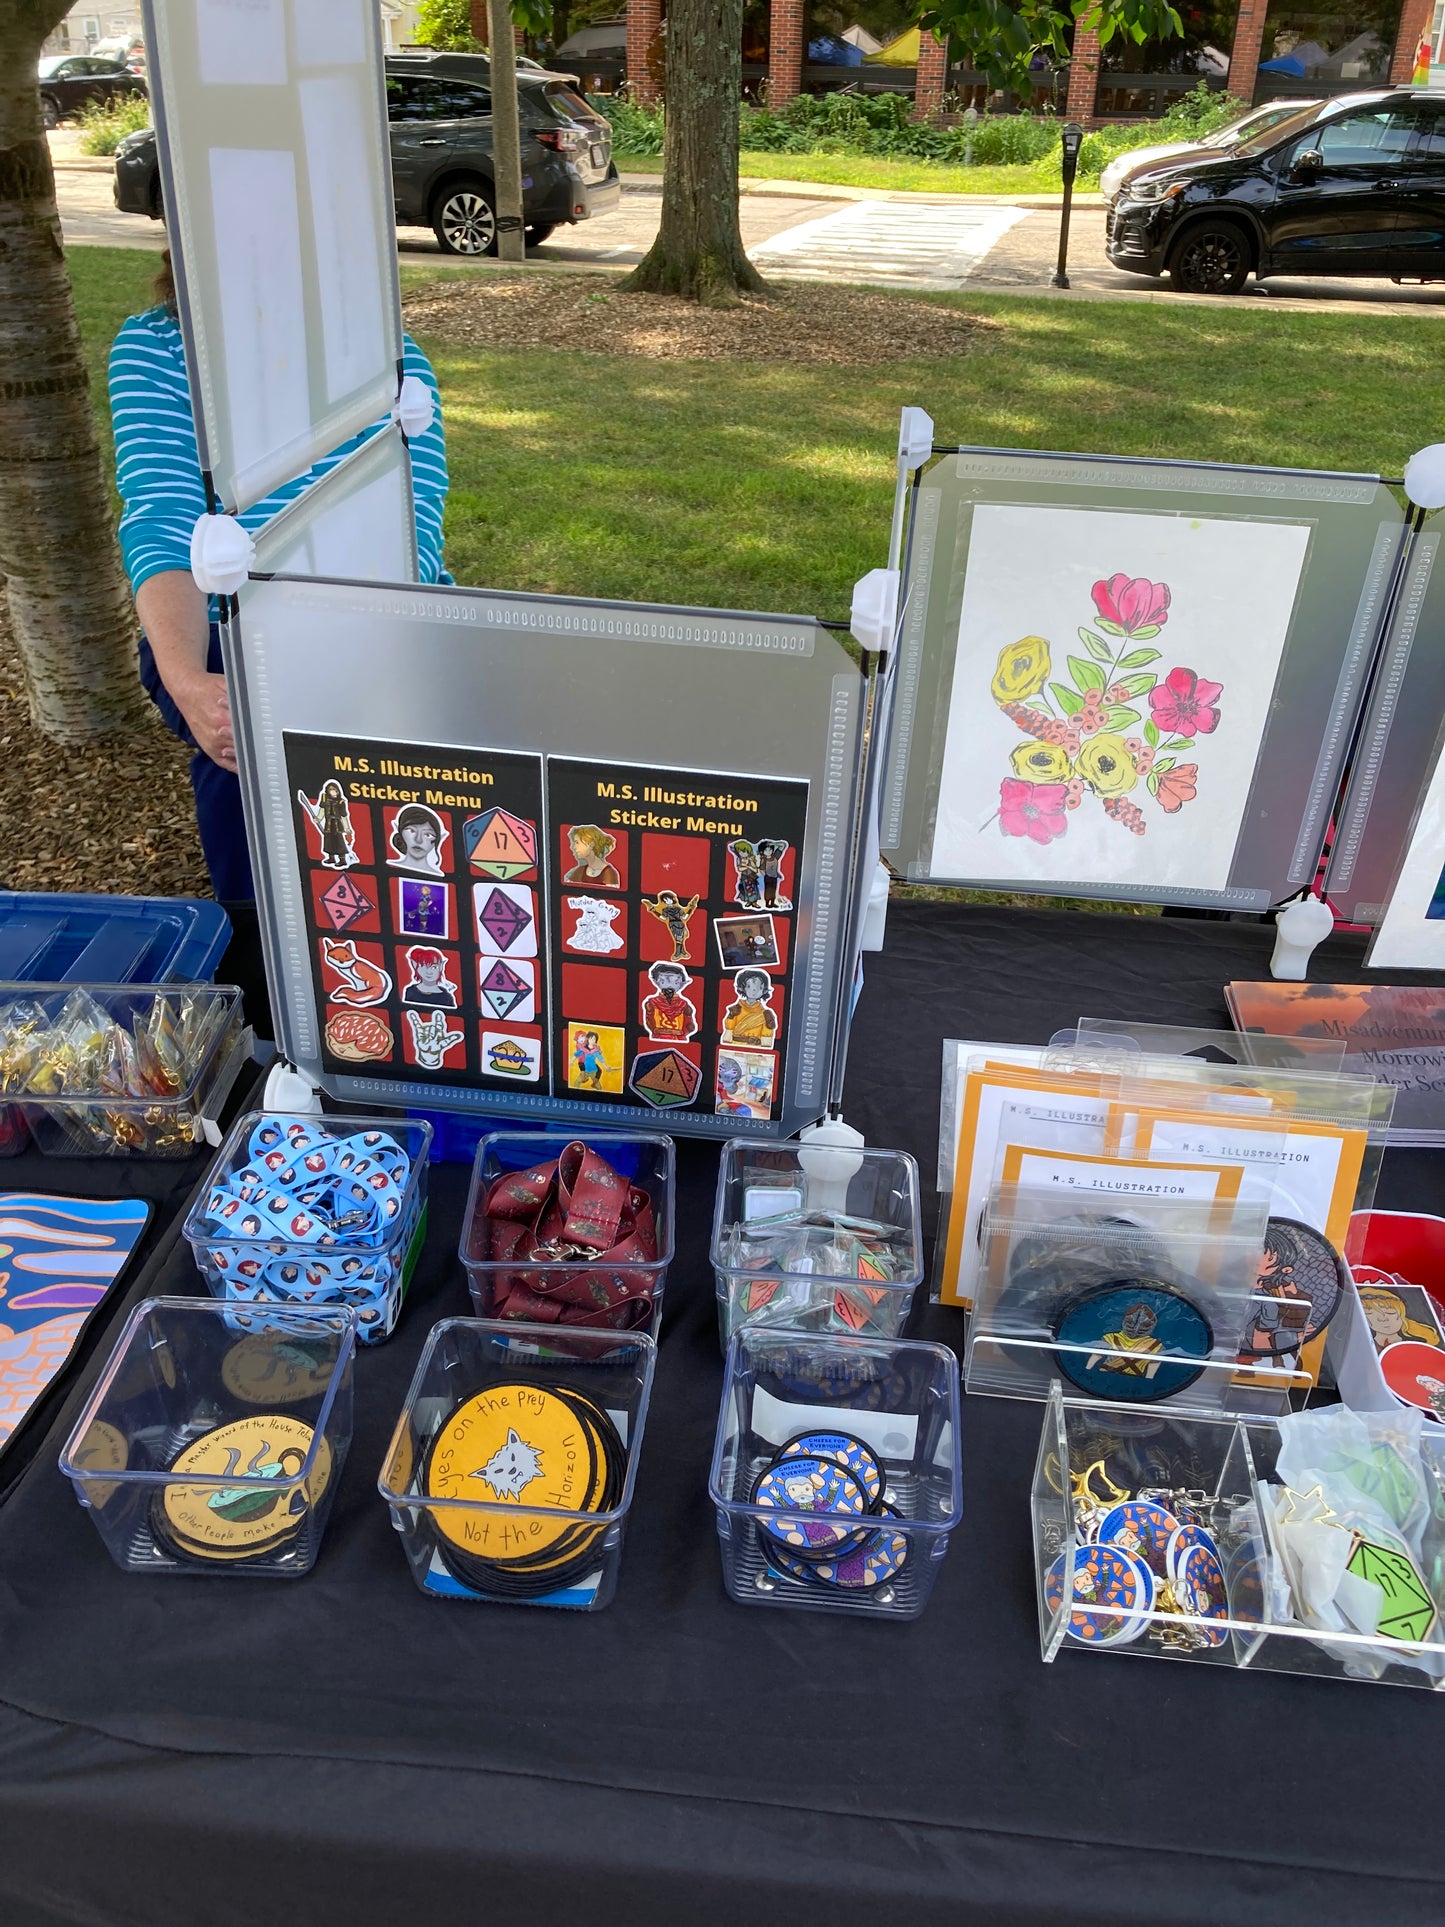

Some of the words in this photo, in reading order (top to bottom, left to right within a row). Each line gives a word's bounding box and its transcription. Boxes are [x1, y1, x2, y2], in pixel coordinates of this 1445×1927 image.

[334, 756, 375, 774] M.S.
[380, 760, 494, 785] Illustration
[350, 782, 420, 802] Sticker
[425, 790, 482, 809] Menu
[597, 783, 638, 800] M.S.
[644, 787, 758, 812] Illustration
[610, 809, 681, 829] Sticker
[686, 817, 743, 836] Menu
[494, 831, 508, 850] 17
[517, 826, 531, 843] 3
[496, 865, 507, 878] 7
[337, 885, 347, 899] 8
[335, 909, 346, 920] 2
[494, 901, 504, 916] 8
[497, 926, 508, 938] 2
[495, 972, 506, 986] 8
[496, 996, 508, 1007] 2
[662, 1067, 674, 1084] 17
[685, 1067, 693, 1082] 3
[655, 1093, 666, 1104] 7
[1010, 1104, 1038, 1116] M.S.
[1183, 1142, 1211, 1155] M.S.
[1220, 1146, 1310, 1163] ILLUSTRATION
[1053, 1175, 1082, 1186] M.S.
[1092, 1179, 1185, 1195] ILLUSTRATION
[240, 1421, 250, 1431] of
[252, 1420, 265, 1430] the
[268, 1418, 293, 1434] House
[453, 1418, 474, 1441] on
[476, 1397, 510, 1416] the
[778, 1463, 801, 1472] CHEESE
[464, 1521, 490, 1544] Not
[499, 1521, 543, 1551] the
[545, 1434, 576, 1509] Horizon
[178, 1512, 202, 1529] Other
[1391, 1558, 1411, 1580] 3
[1375, 1572, 1398, 1598] 17
